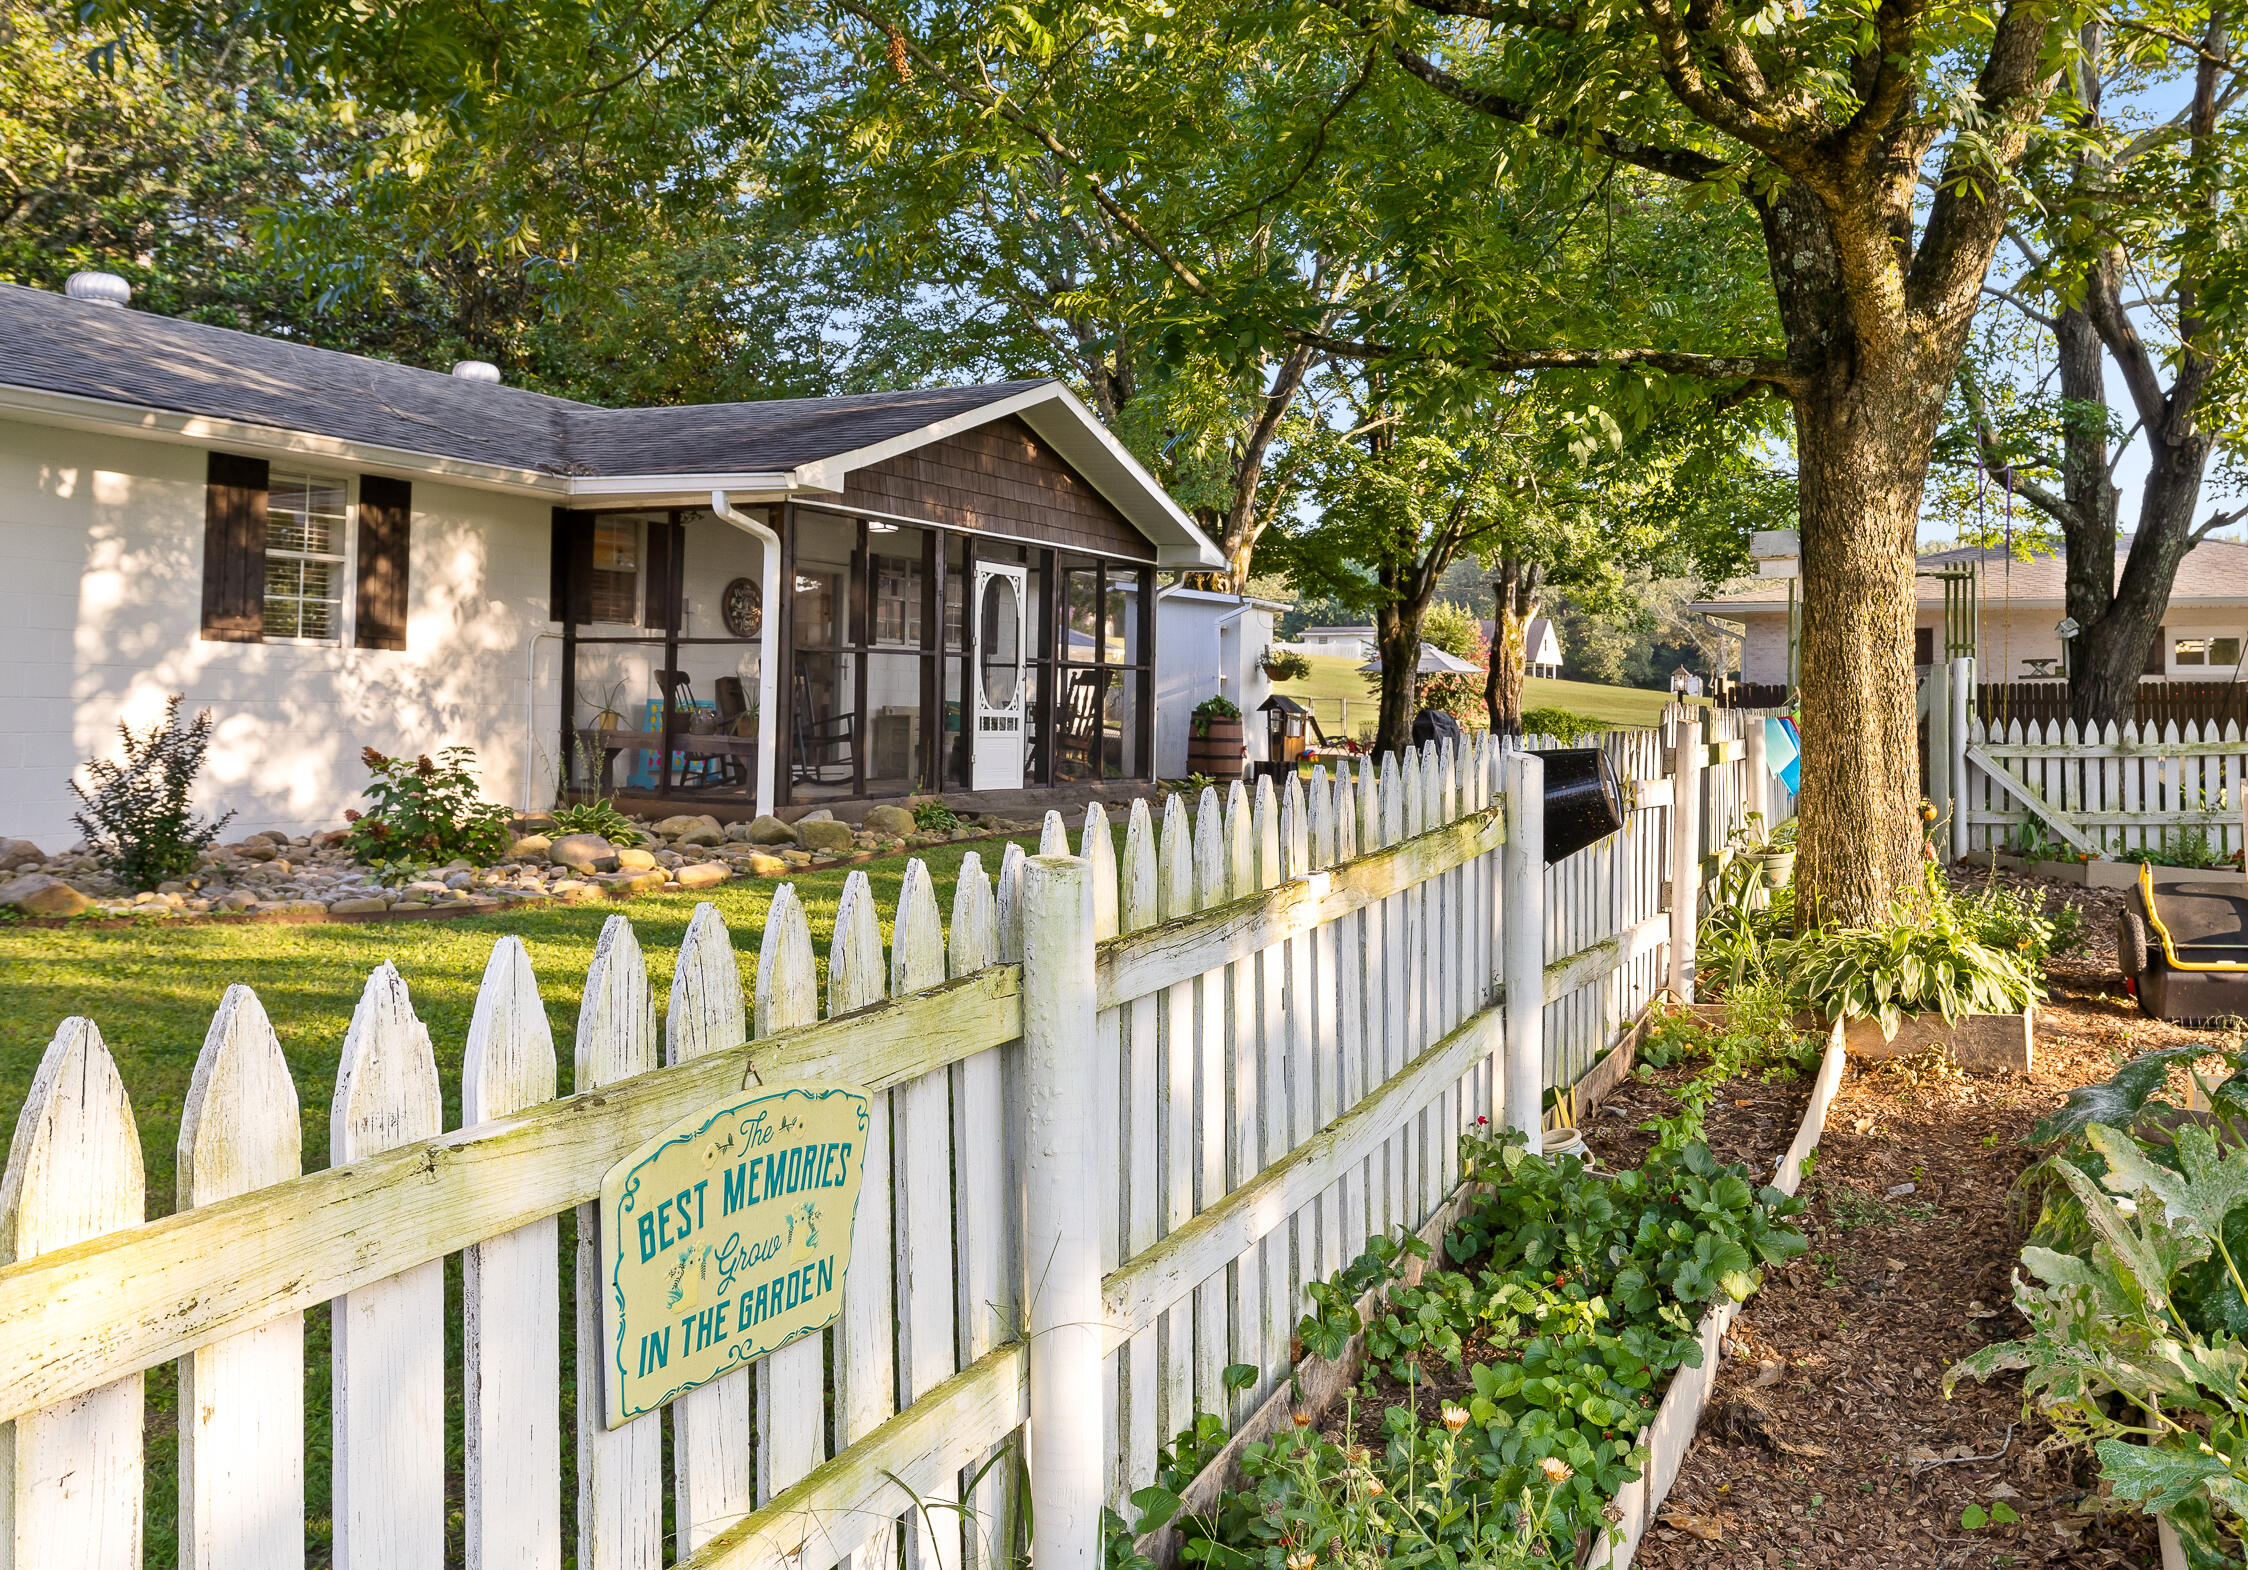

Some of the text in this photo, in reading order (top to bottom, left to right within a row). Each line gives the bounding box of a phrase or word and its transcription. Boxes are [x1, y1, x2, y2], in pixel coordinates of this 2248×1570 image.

[739, 1110, 774, 1157] The
[637, 1143, 851, 1264] BEST MEMORIES
[715, 1231, 782, 1295] Grow
[638, 1255, 834, 1379] IN THE GARDEN
